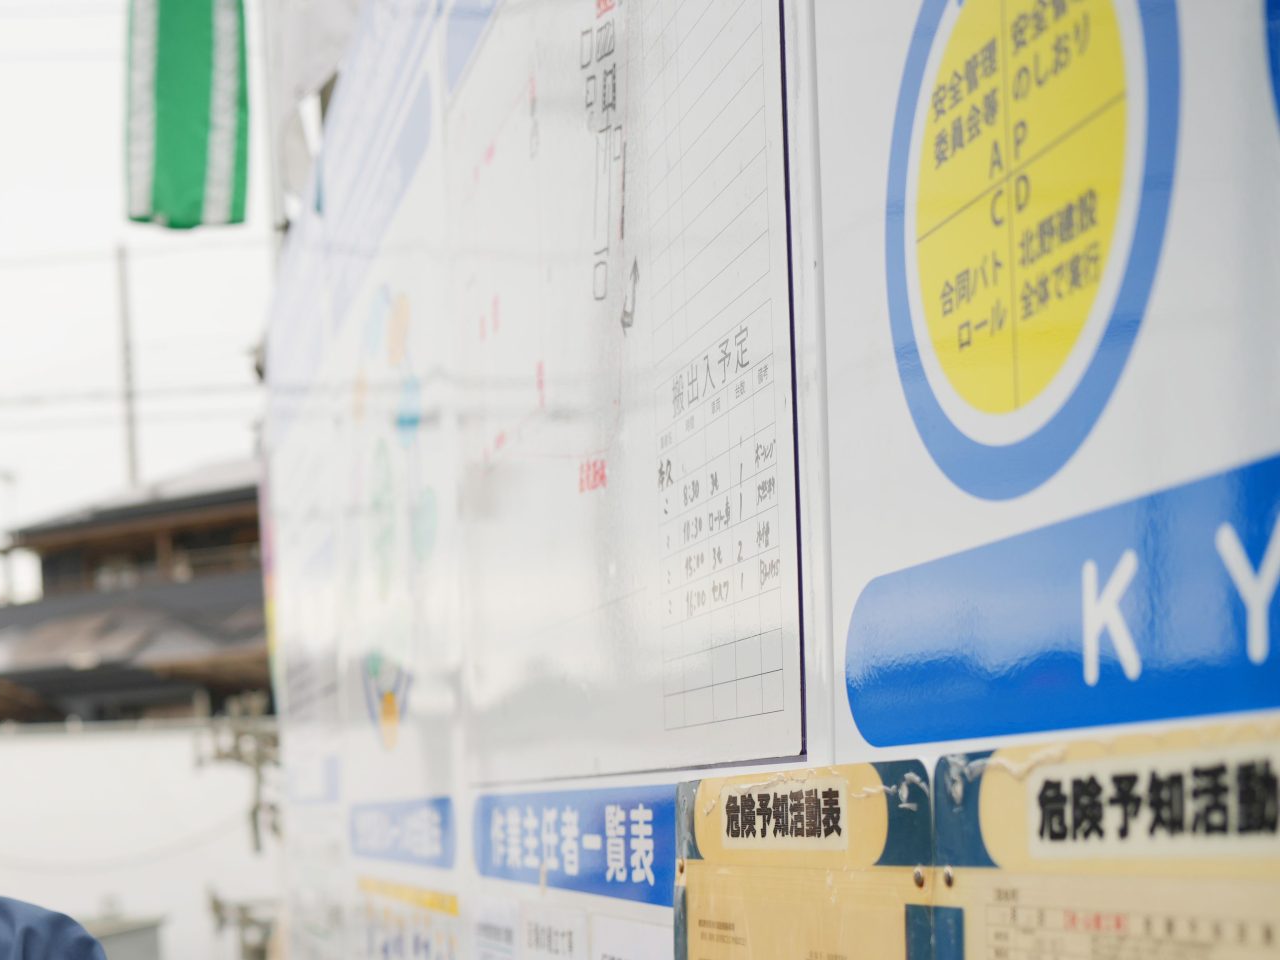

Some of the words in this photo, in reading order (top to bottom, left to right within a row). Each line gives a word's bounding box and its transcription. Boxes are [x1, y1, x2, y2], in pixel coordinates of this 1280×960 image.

[1011, 0, 1084, 56] 安全管
[1012, 12, 1090, 101] のしおり
[932, 37, 997, 124] 安全管理
[934, 88, 998, 170] 委員会等
[989, 140, 1003, 179] A
[1014, 120, 1027, 161] P
[991, 189, 1004, 227] C
[1015, 174, 1030, 212] D
[1019, 188, 1098, 267] 北野建設
[1021, 242, 1100, 321] 全体で実行
[958, 299, 1007, 351] ロール
[672, 325, 750, 418] 搬出入予定
[724, 787, 843, 839] 危険予知活動表
[1037, 759, 1278, 842] 危険予知活動
[491, 803, 656, 887] 作業主任者一覧表
